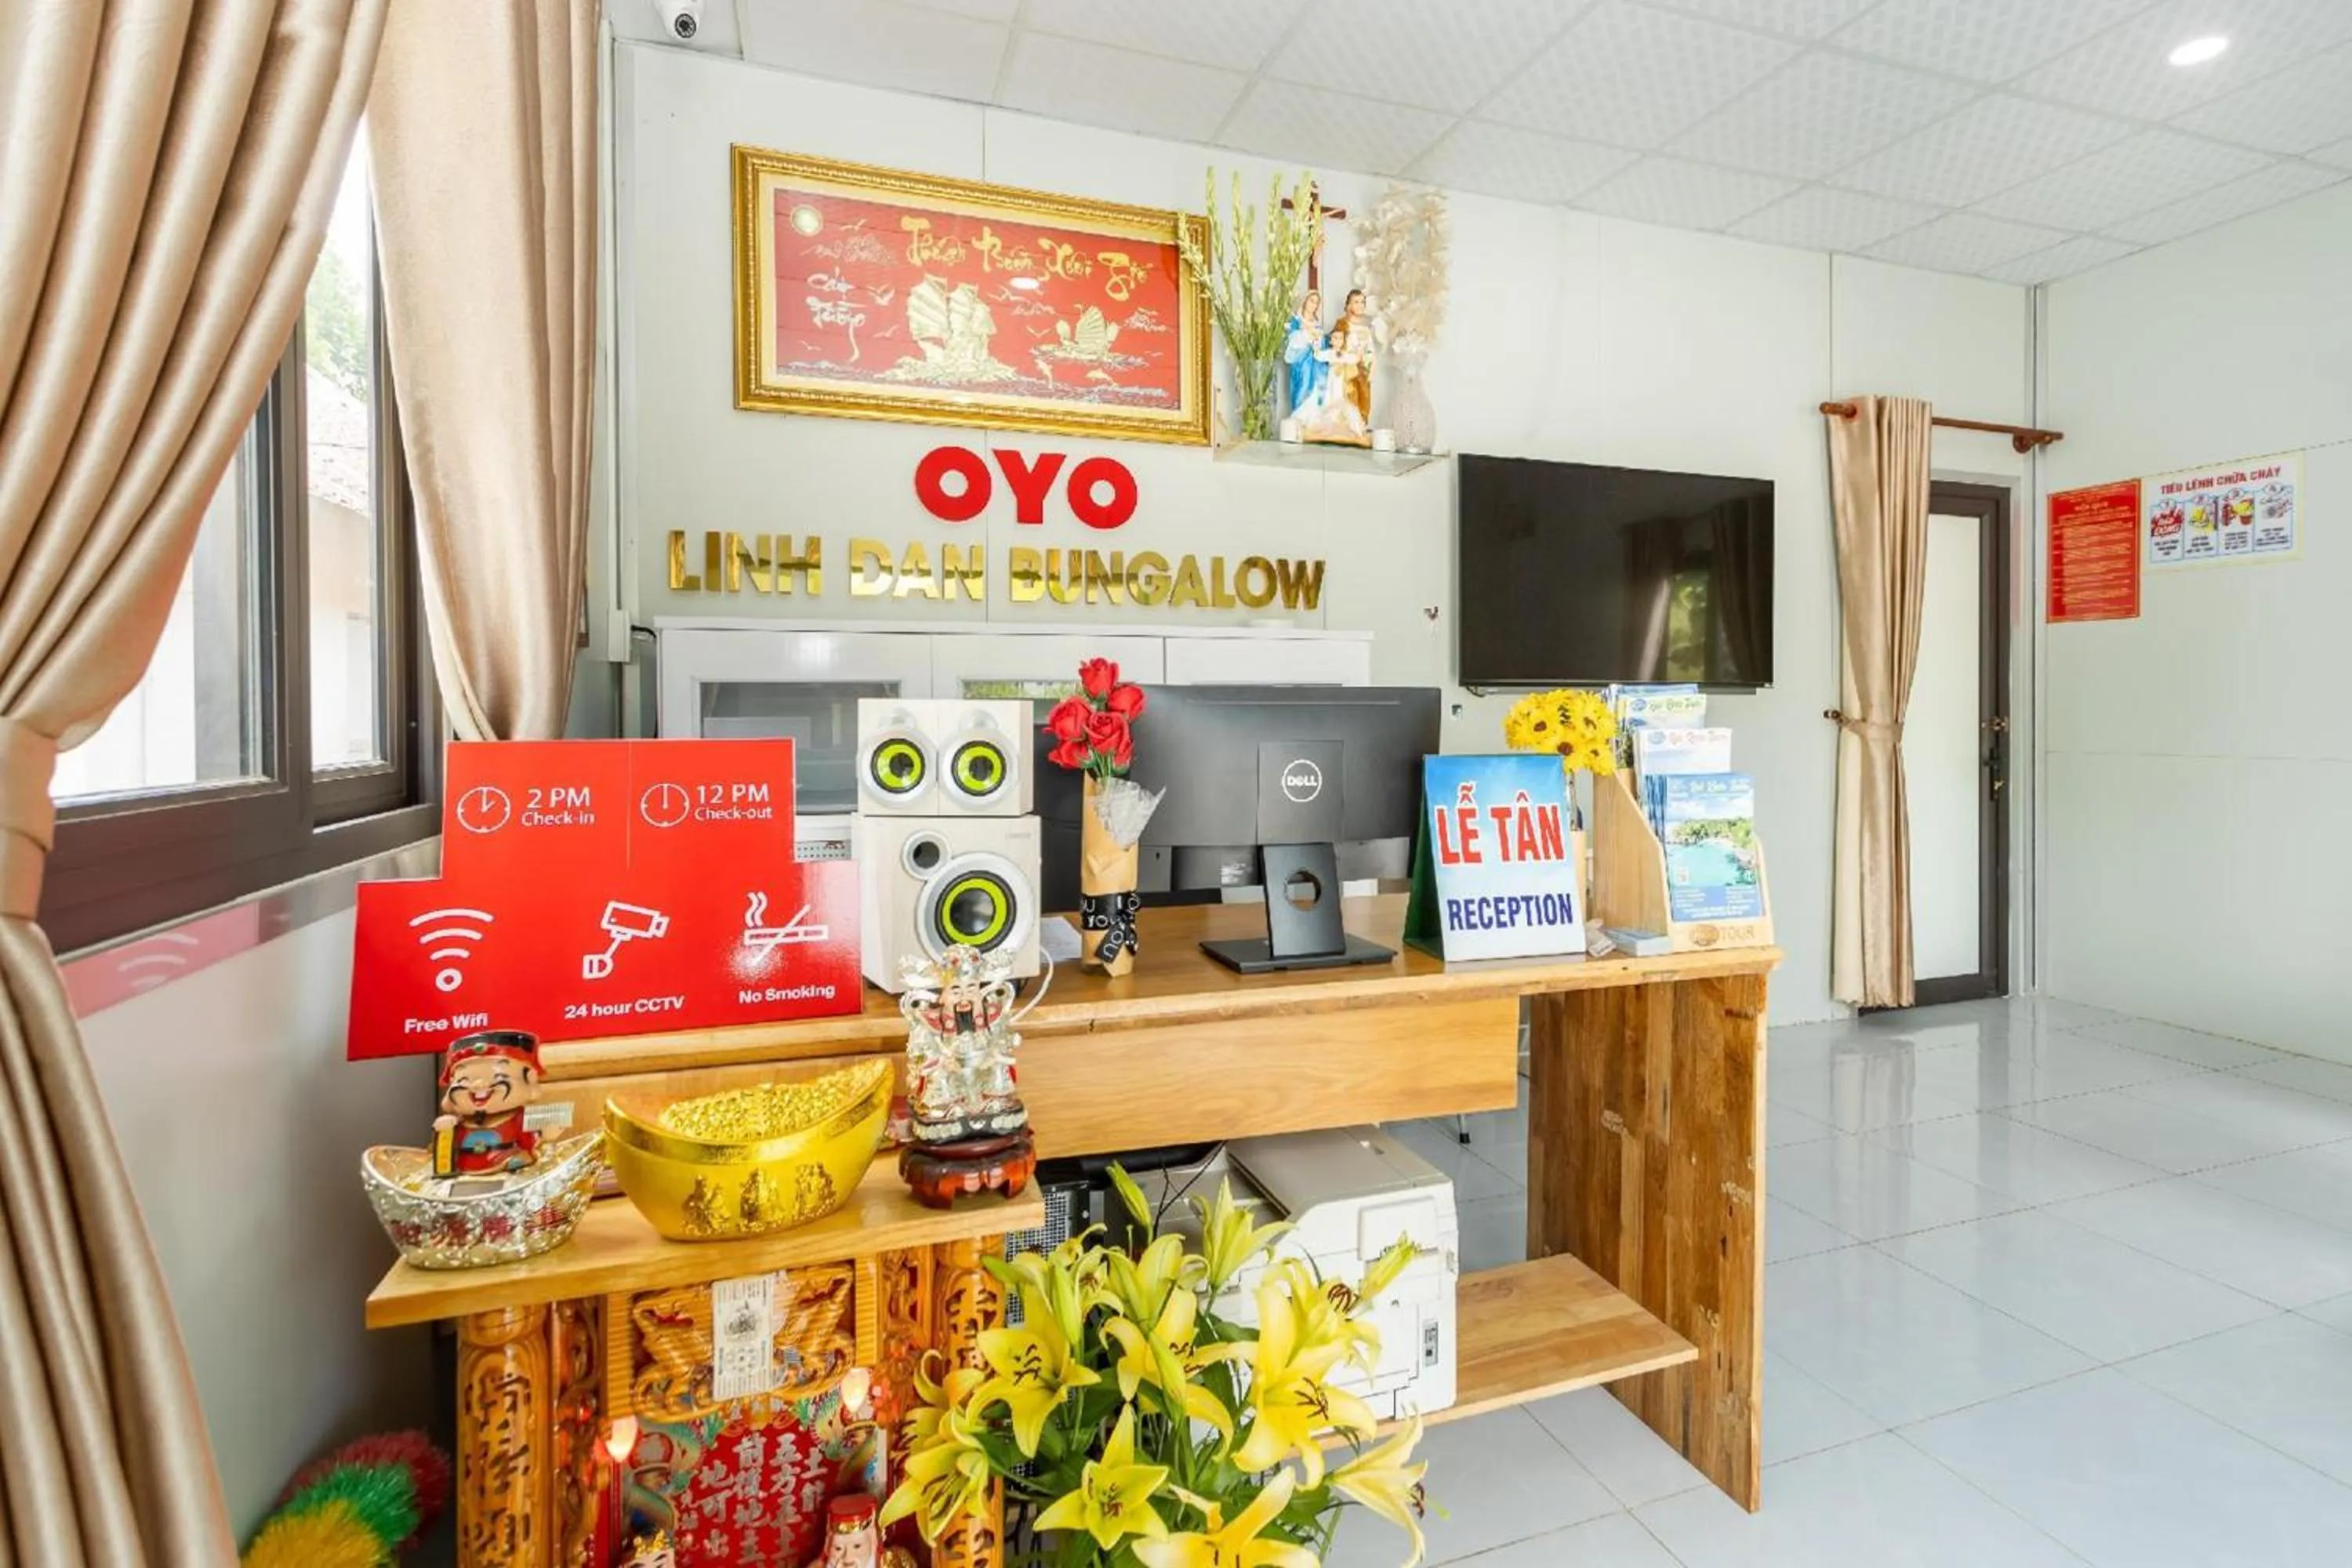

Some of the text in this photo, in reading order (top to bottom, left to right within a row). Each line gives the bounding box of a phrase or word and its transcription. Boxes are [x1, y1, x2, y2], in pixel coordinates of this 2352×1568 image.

[915, 446, 1138, 530] OYO
[668, 529, 1327, 611] LINH DAN BUNGALOW
[1287, 775, 1318, 786] DELL
[527, 787, 591, 808] 2 PM
[697, 784, 770, 804] 12 PM
[521, 808, 595, 827] Check-in
[695, 805, 772, 823] Check-out
[1435, 784, 1565, 866] LỄ TÂN
[1446, 893, 1573, 931] RECEPTION
[739, 983, 836, 1004] No Smoking
[564, 996, 685, 1019] 24 hour CCTV
[404, 1013, 488, 1033] Free Wifi
